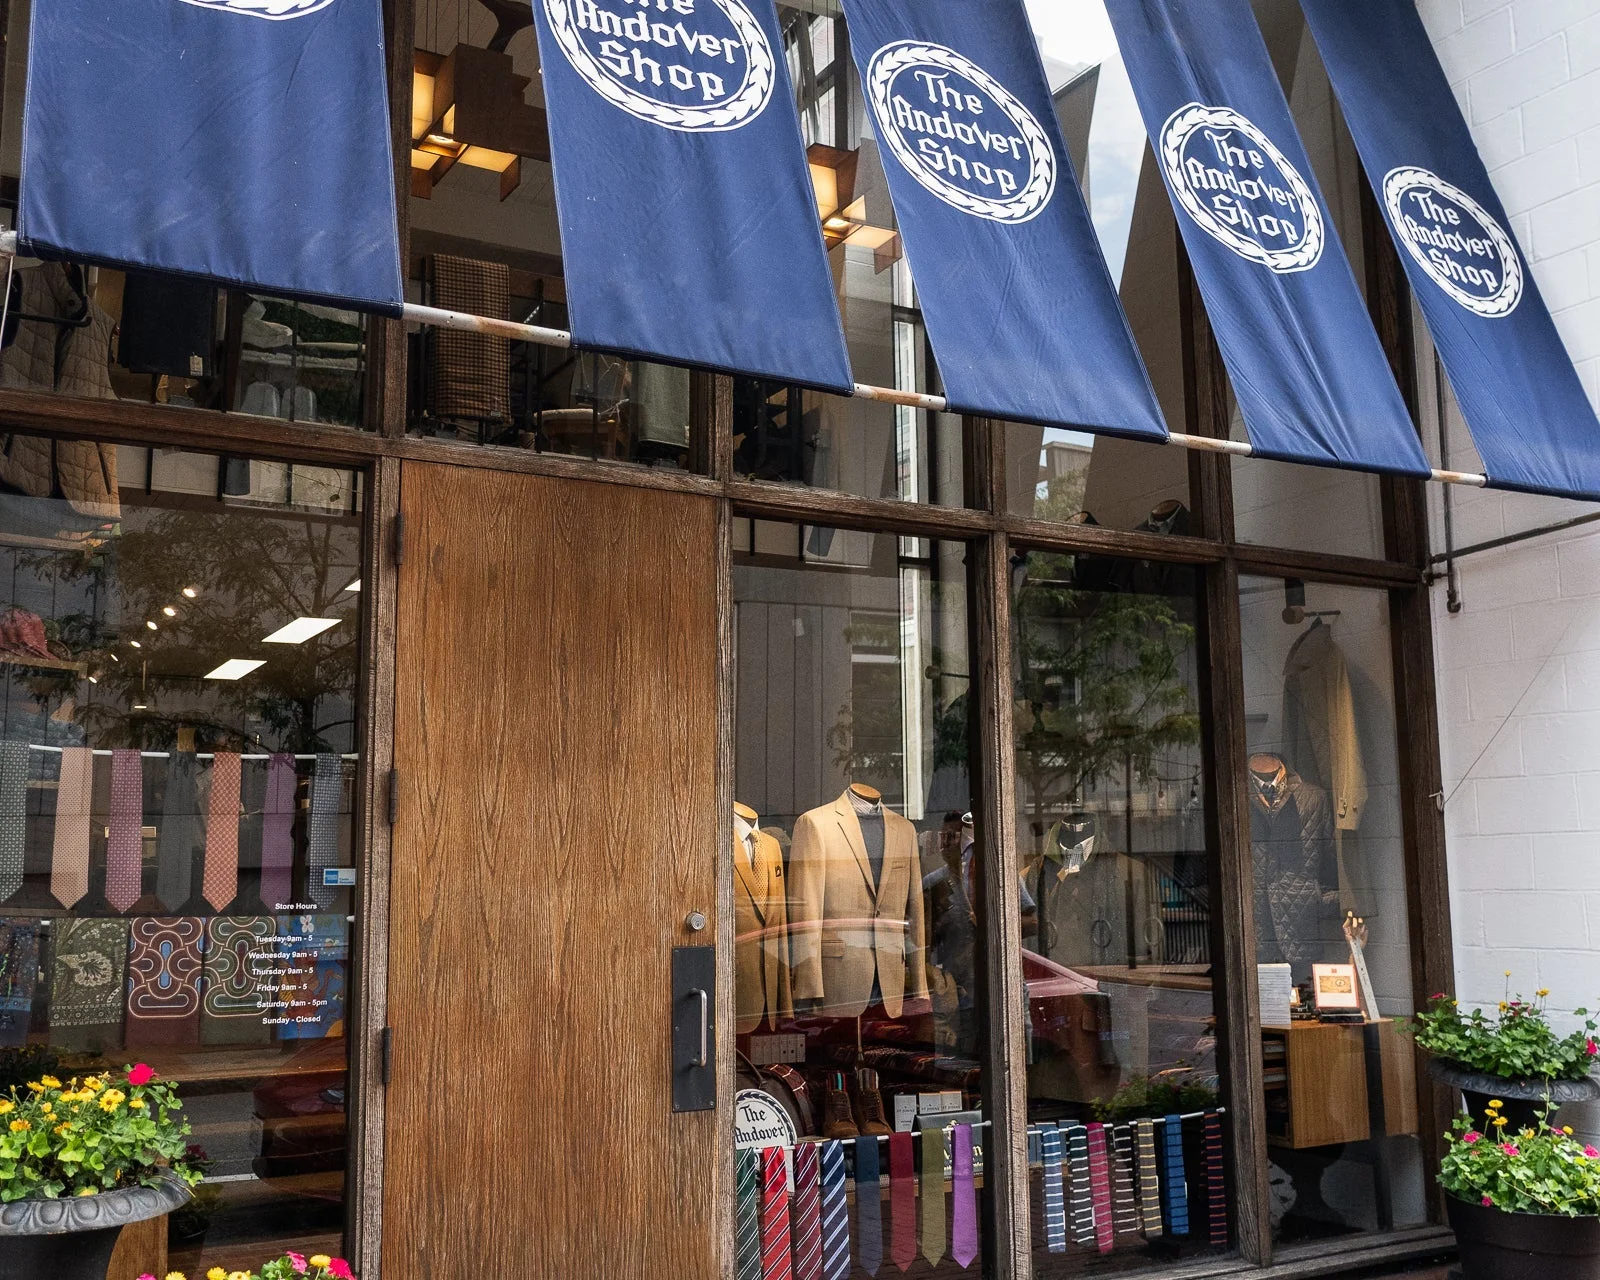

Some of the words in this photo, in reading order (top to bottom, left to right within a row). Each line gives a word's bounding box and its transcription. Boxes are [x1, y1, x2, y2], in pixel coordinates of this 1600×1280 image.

[576, 0, 744, 65] Andover
[598, 40, 726, 101] Shop
[914, 70, 984, 115] The
[892, 94, 1024, 160] Andover
[917, 137, 1018, 196] Shop
[1204, 129, 1265, 170] The
[1185, 156, 1297, 214] Andover
[1211, 193, 1299, 245] Shop
[1409, 190, 1461, 226] The
[1404, 214, 1494, 260] Andover
[1428, 247, 1499, 293] Shop
[275, 902, 294, 910] Store
[296, 902, 317, 910] Hours
[248, 951, 290, 960] Wednesday
[255, 935, 286, 944] Tuesday
[252, 968, 286, 976] Thursday
[287, 967, 303, 975] 9am
[256, 984, 280, 993] Friday
[256, 1000, 290, 1008] Saturday
[312, 999, 328, 1007] 5pm
[262, 1017, 290, 1025] Sunday
[739, 1105, 767, 1123] The
[734, 1125, 785, 1144] Andover
